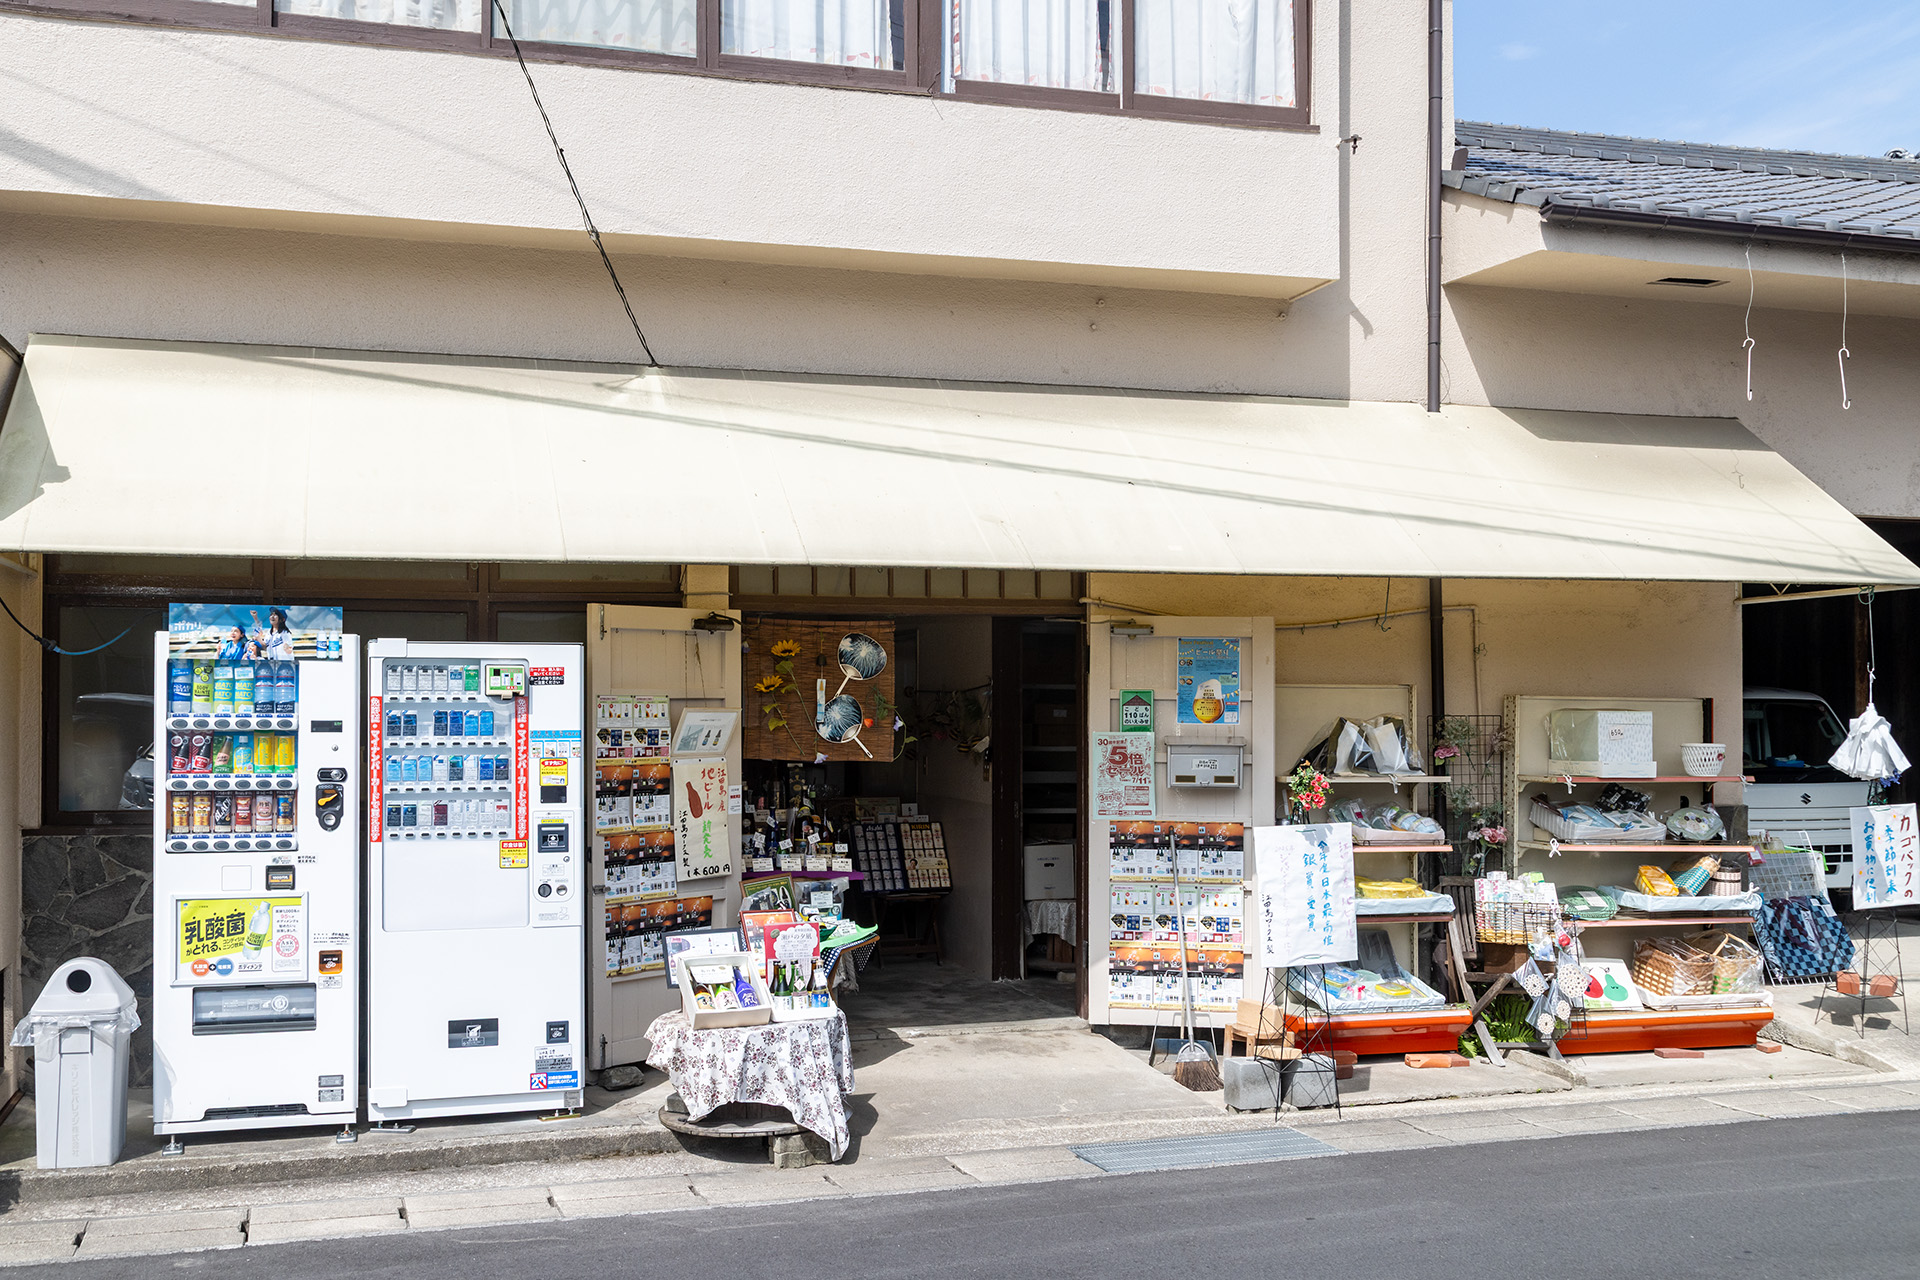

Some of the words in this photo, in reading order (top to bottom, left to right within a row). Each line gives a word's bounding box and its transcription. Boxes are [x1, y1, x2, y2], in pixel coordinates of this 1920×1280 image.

[1109, 746, 1144, 765] 5倍
[1106, 765, 1144, 776] セール
[701, 768, 714, 810] 地ビール
[185, 912, 246, 945] 乳酸菌
